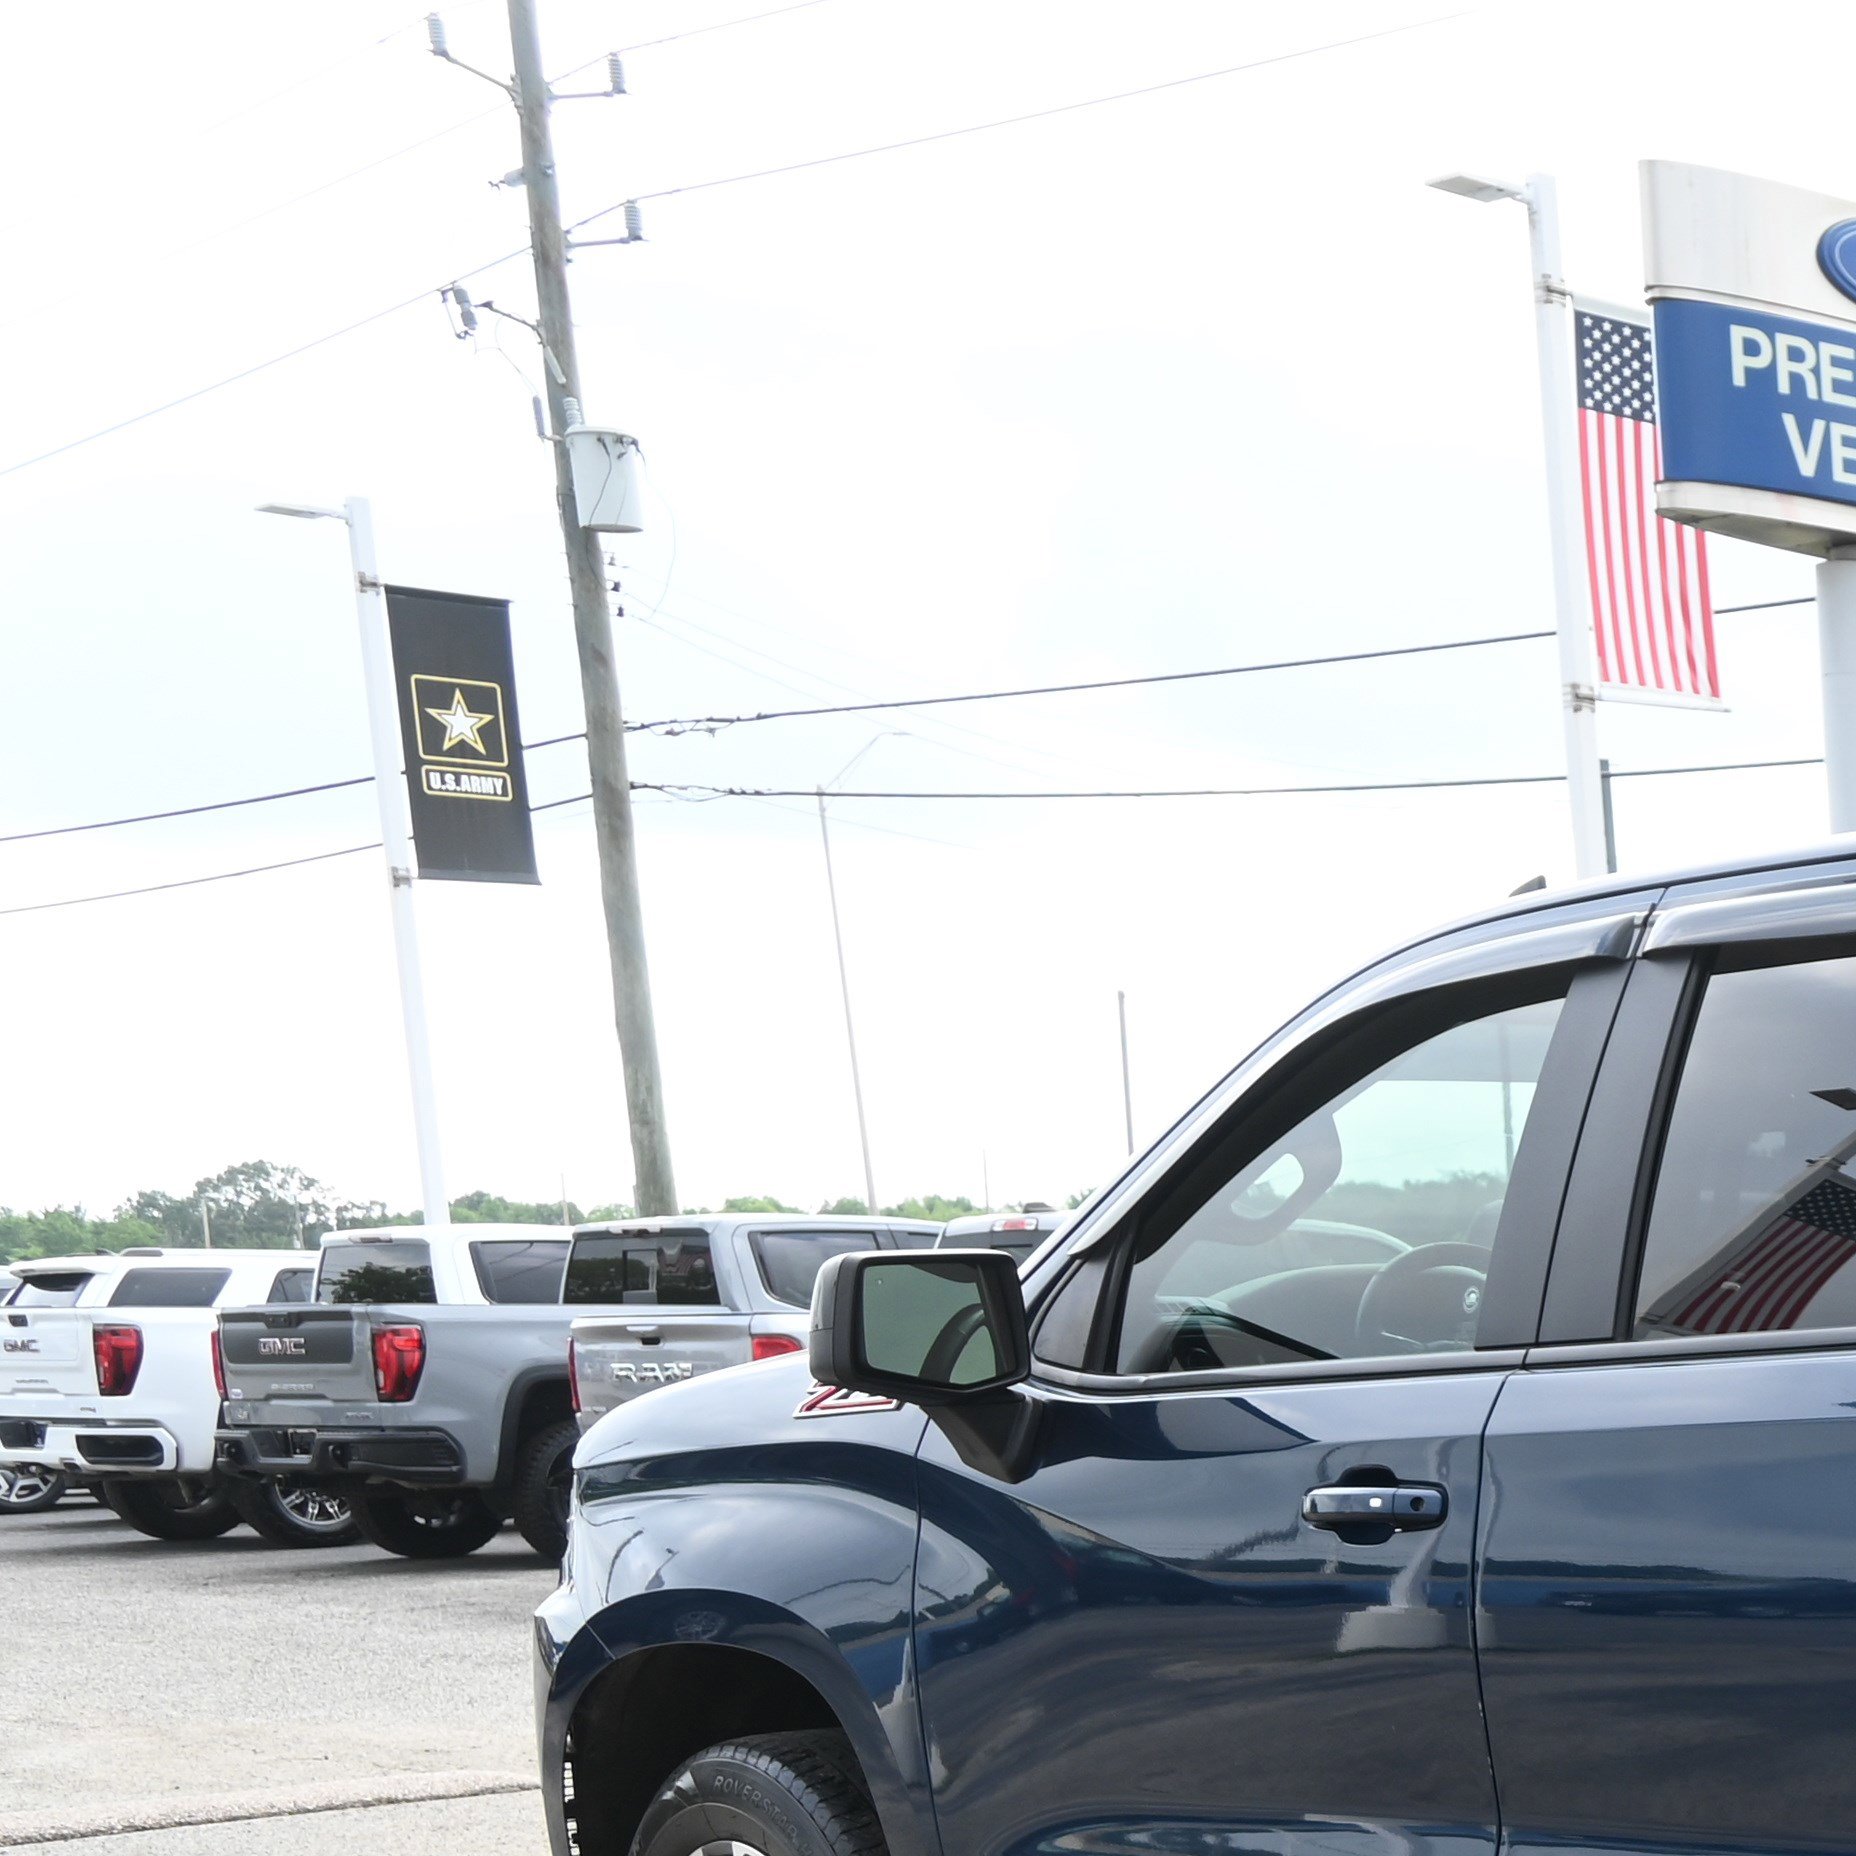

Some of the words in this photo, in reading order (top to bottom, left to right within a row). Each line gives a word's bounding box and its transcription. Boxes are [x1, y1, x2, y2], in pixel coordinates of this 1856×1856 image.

[3, 1338, 41, 1352] GMC
[257, 1337, 306, 1356] GMC
[610, 1362, 694, 1384] RAM
